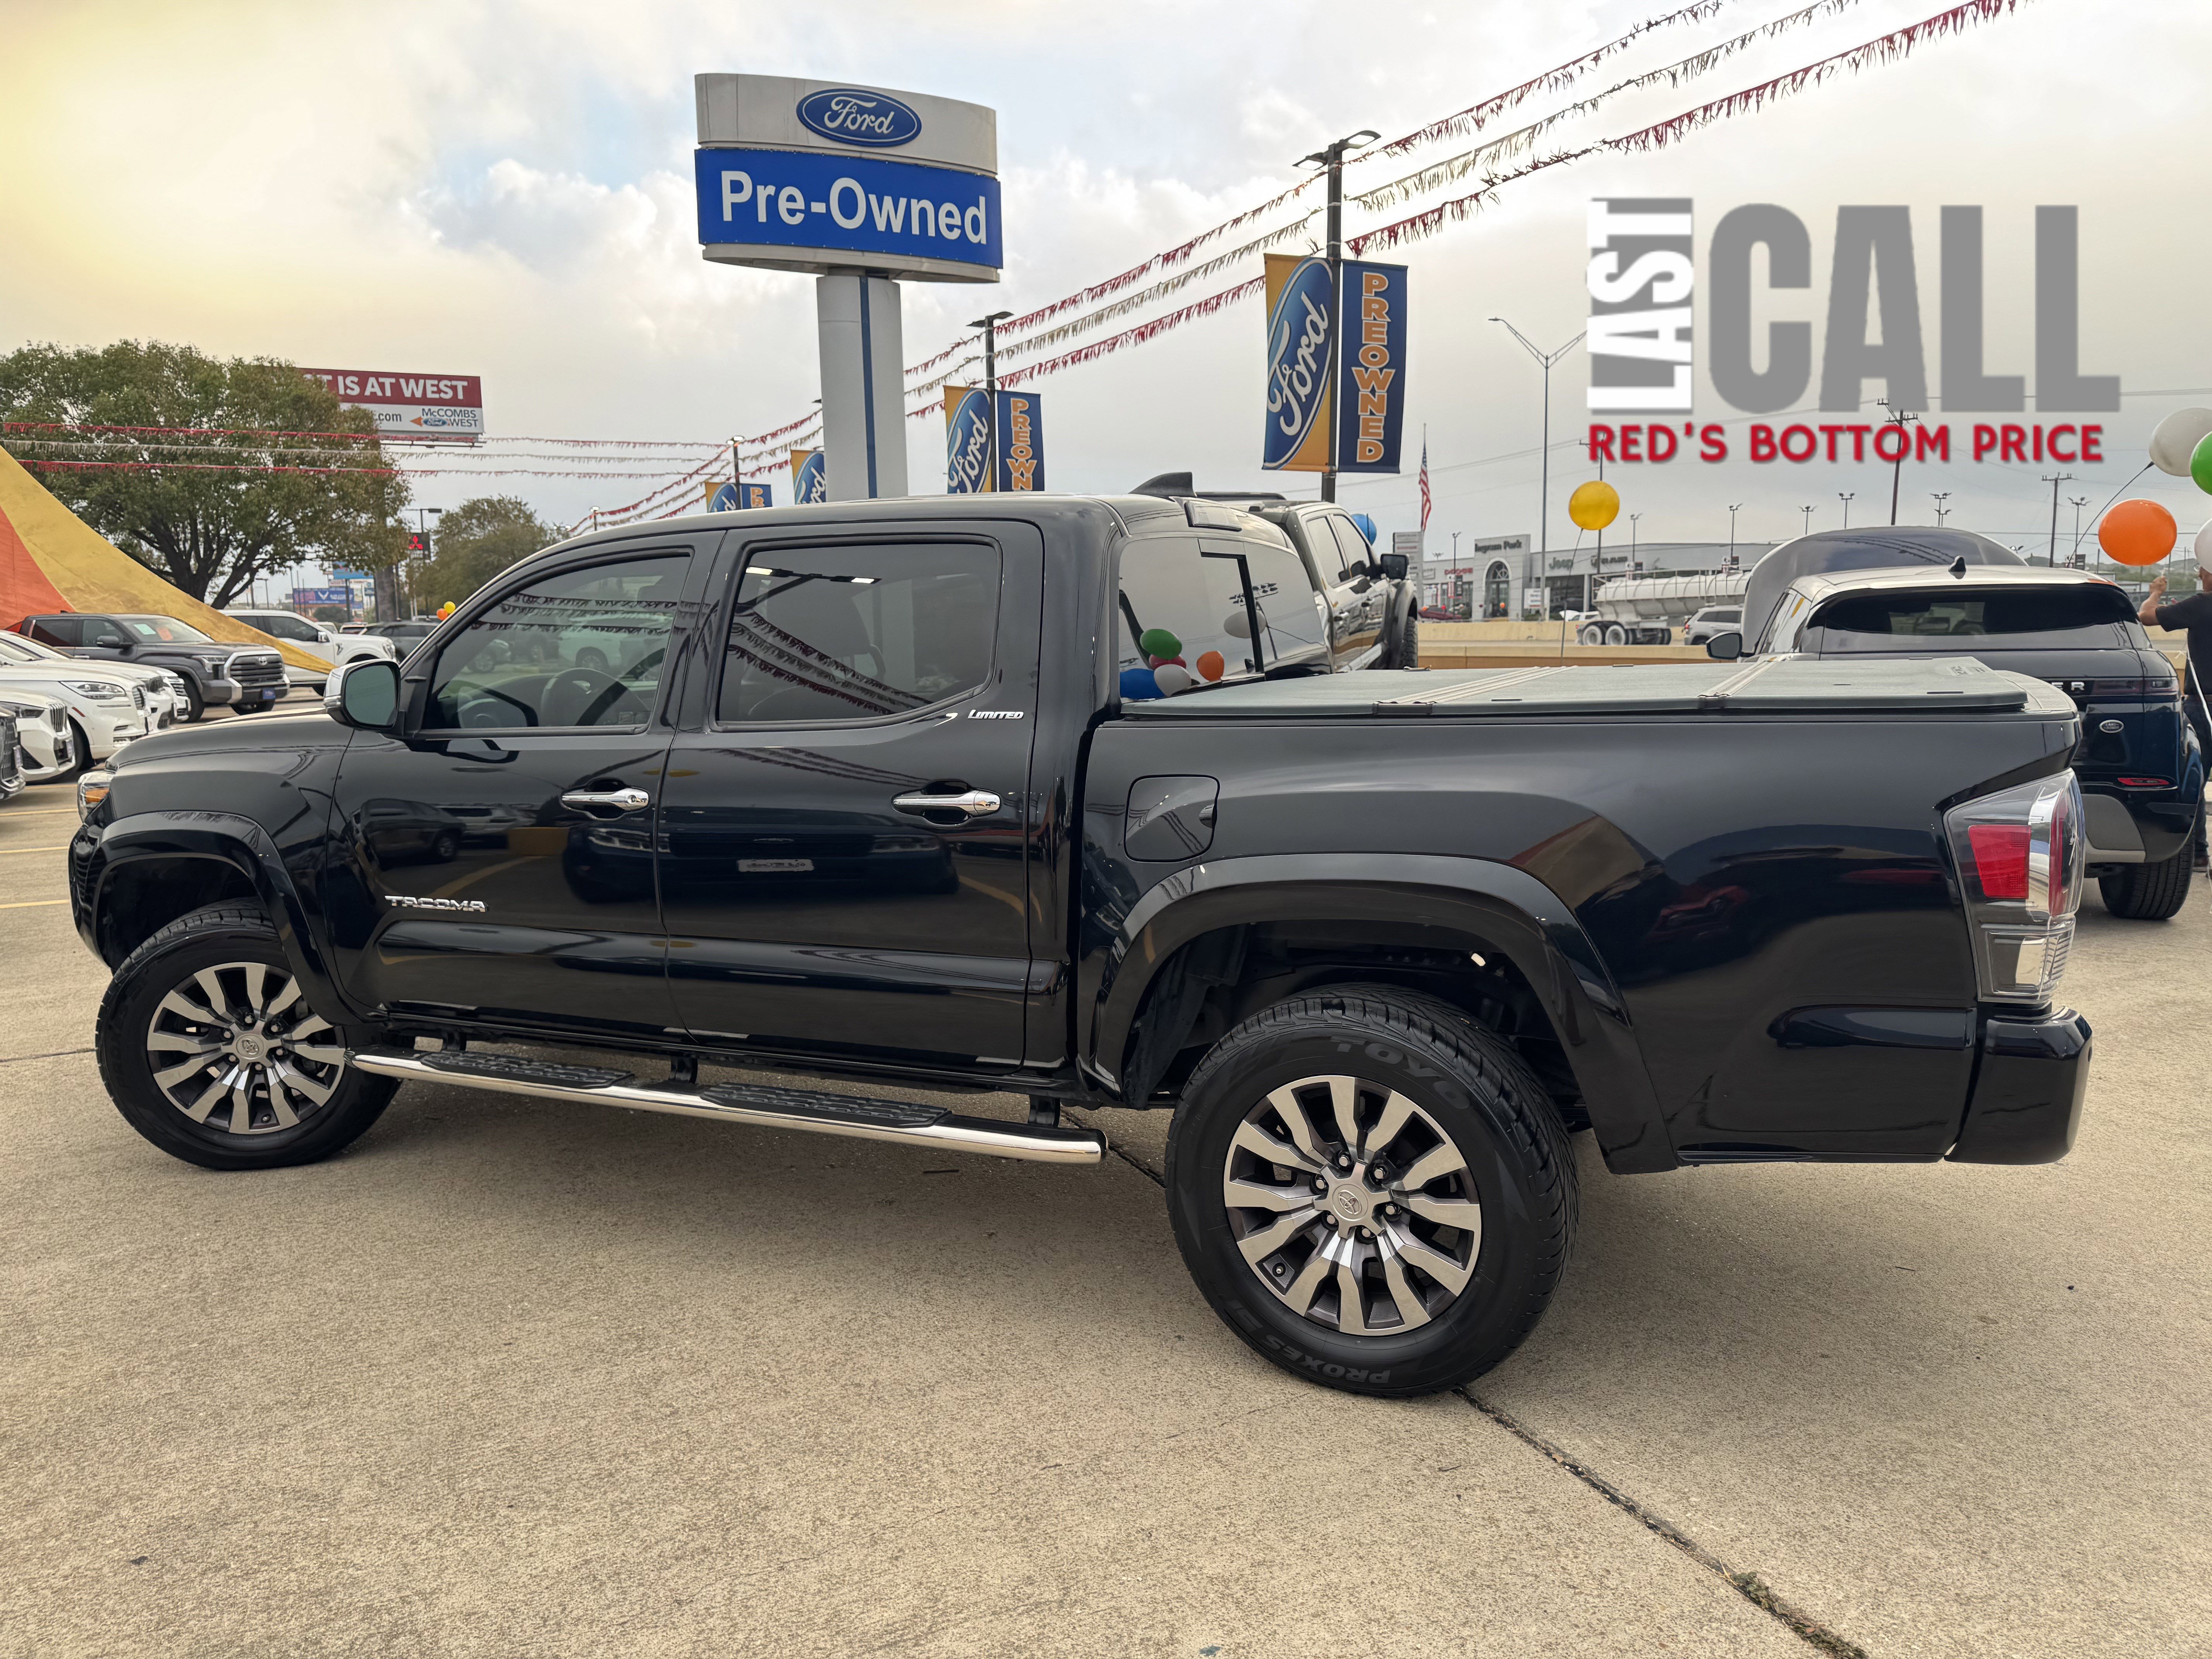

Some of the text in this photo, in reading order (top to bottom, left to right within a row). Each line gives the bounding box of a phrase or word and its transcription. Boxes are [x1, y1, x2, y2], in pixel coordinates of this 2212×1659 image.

[824, 96, 895, 134] Ford
[721, 171, 987, 244] Pre-Owned
[1268, 291, 1328, 436] Ford
[1351, 271, 1396, 463] PREOWNED
[337, 376, 360, 395] IS
[364, 377, 395, 397] AT
[399, 378, 467, 400] WEST
[422, 408, 476, 419] McCOMBS
[449, 418, 478, 428] WEST
[385, 895, 486, 912] TACOMA
[1330, 1035, 1470, 1109] TOYO
[1262, 1334, 1391, 1383] PROXES
